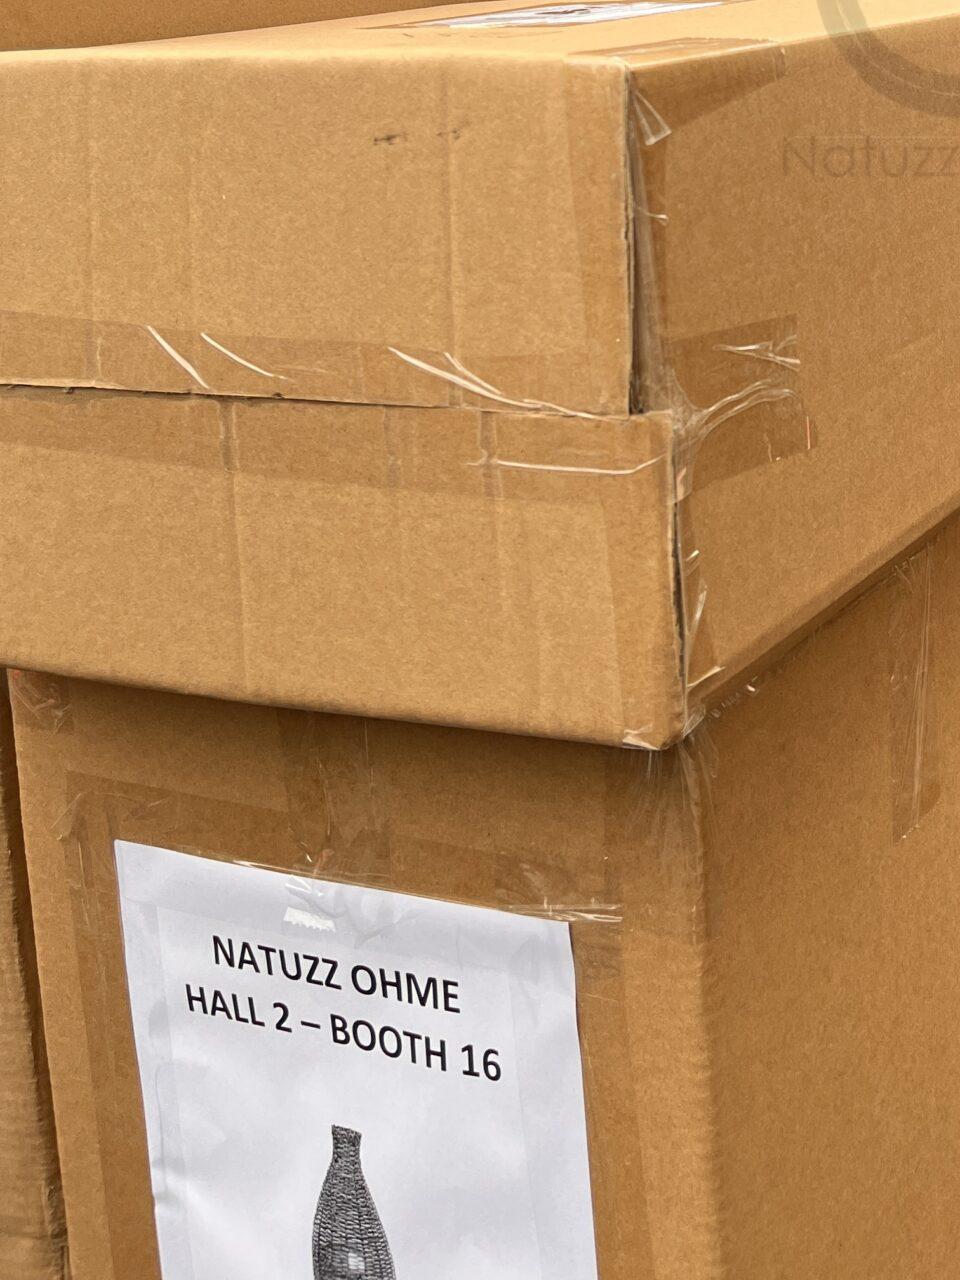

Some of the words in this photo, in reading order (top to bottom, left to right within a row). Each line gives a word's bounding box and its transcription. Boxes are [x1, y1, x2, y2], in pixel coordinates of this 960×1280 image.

[212, 934, 342, 991] NATUZZ
[351, 965, 461, 1013] OHME
[185, 983, 265, 1027] HALL
[272, 1001, 293, 1033] 2
[330, 1013, 447, 1072] BOOTH
[460, 1044, 502, 1082] 16
